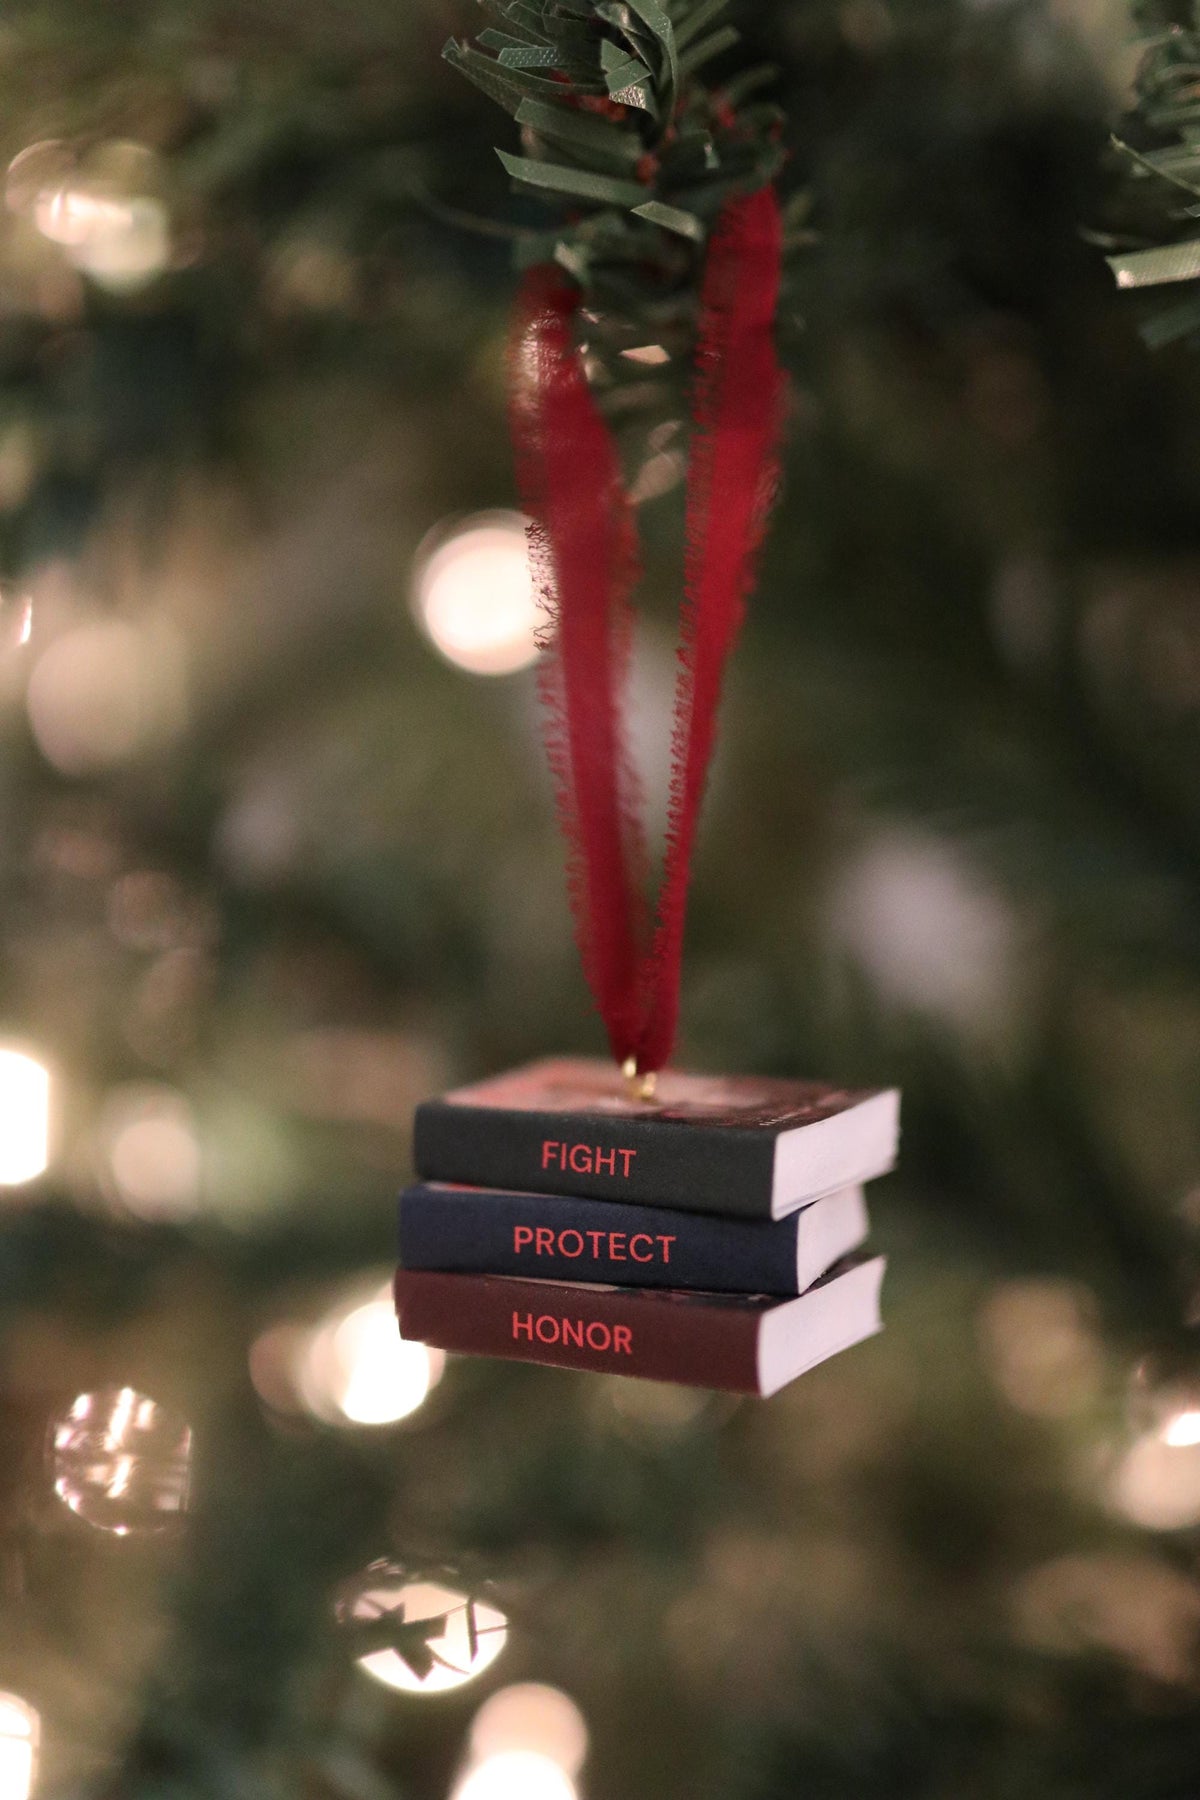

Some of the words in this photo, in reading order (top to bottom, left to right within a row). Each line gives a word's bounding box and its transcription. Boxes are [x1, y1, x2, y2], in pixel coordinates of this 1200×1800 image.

[541, 1141, 637, 1178] FIGHT
[513, 1226, 676, 1263] PROTECT
[512, 1311, 633, 1354] HONOR
